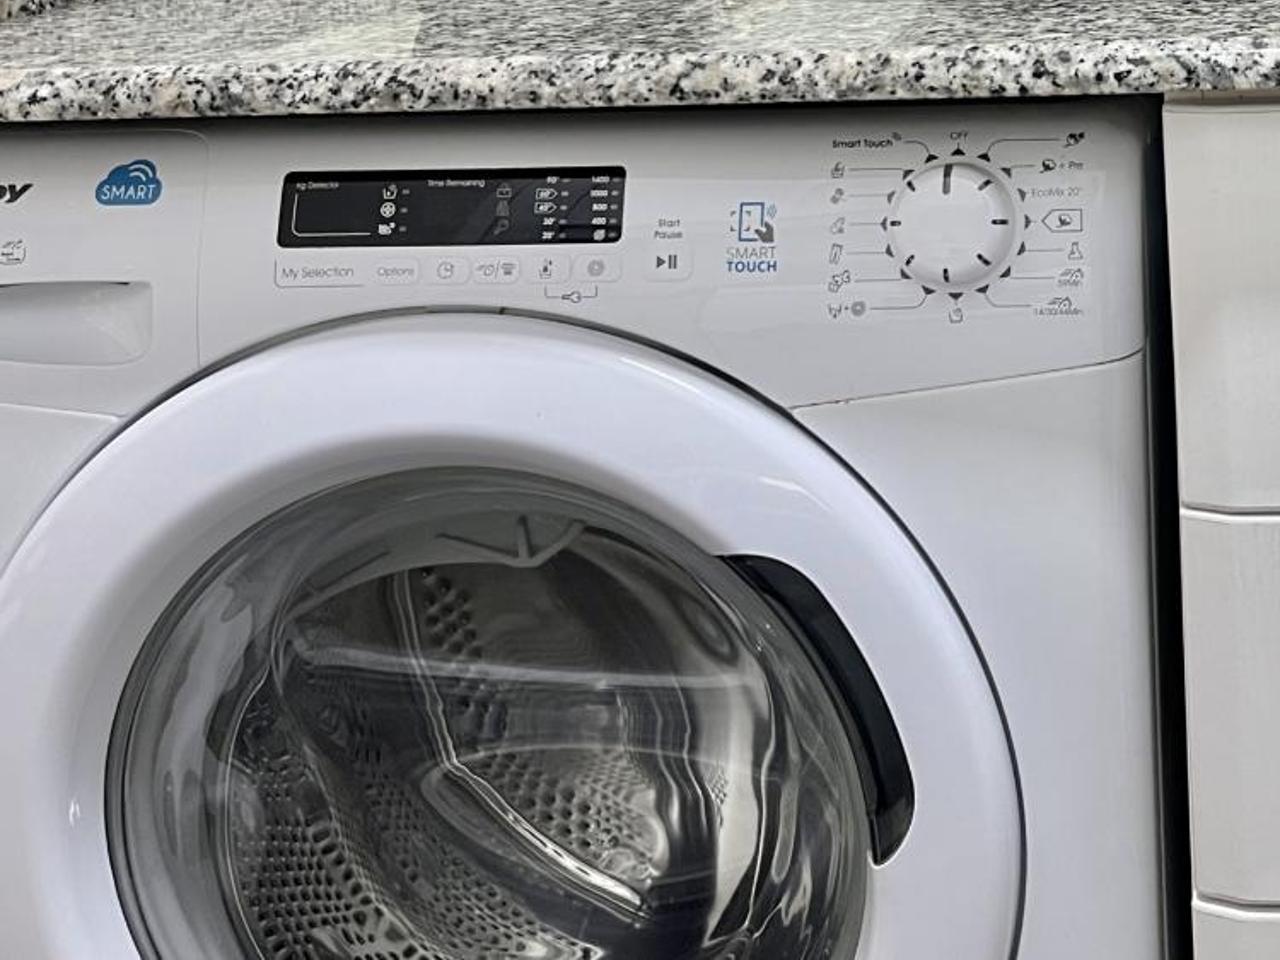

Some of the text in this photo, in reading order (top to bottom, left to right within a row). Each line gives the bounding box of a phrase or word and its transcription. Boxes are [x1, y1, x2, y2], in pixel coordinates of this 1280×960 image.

[832, 138, 893, 149] Smart Touch
[100, 184, 157, 200] SMART
[658, 218, 681, 228] Start
[726, 246, 776, 260] SMART
[282, 265, 355, 280] My Selection
[376, 265, 415, 279] Options
[726, 260, 778, 273] TOUCH
